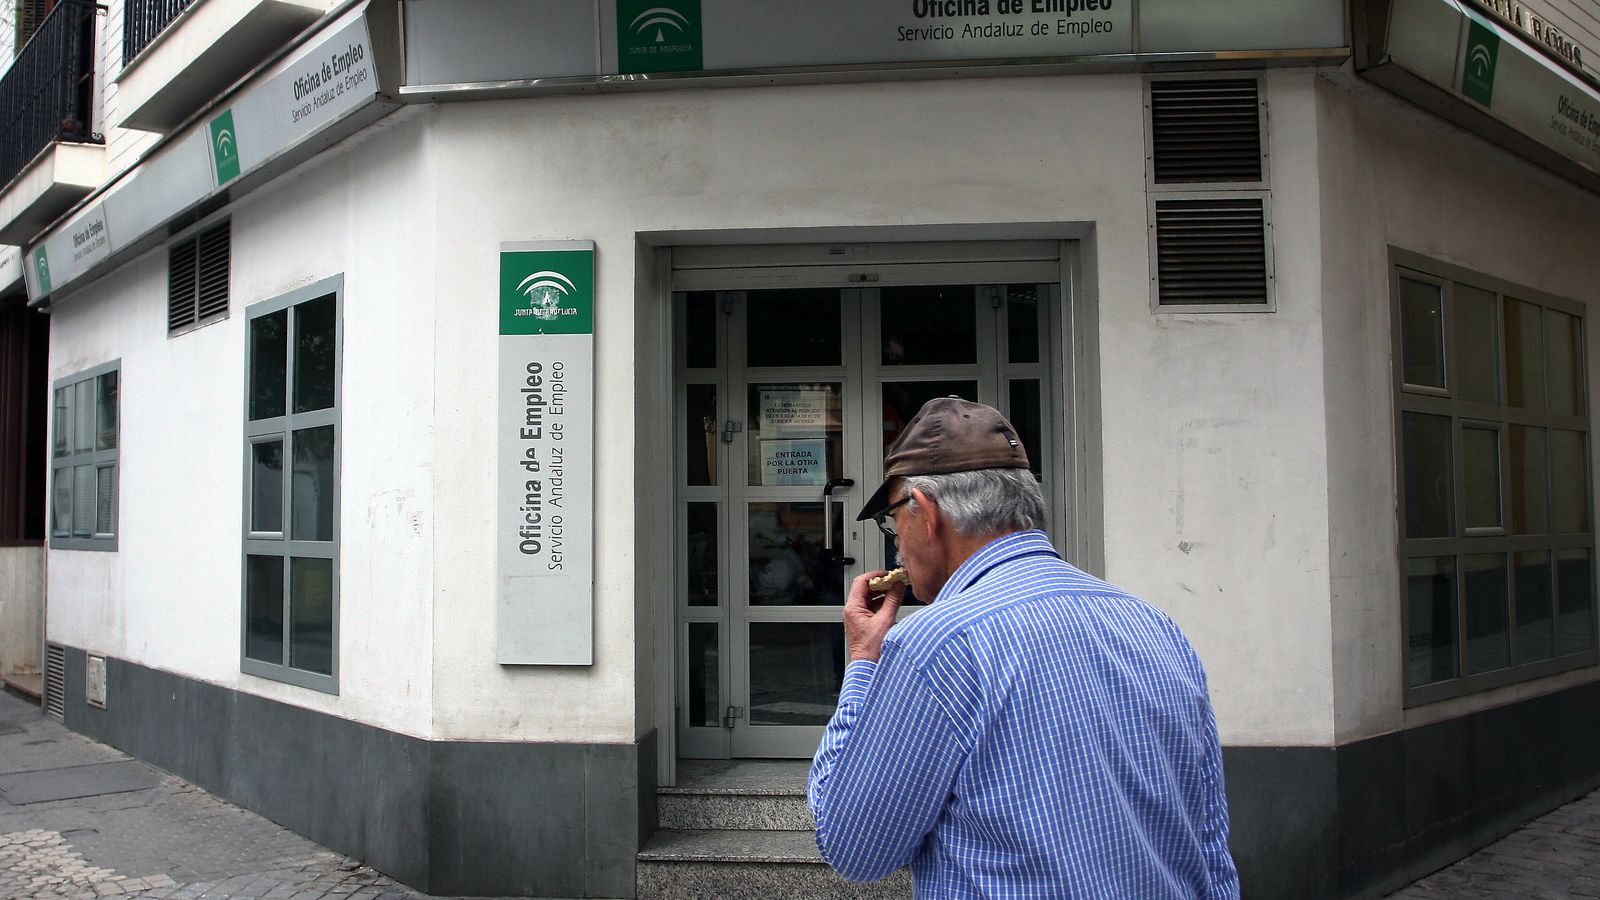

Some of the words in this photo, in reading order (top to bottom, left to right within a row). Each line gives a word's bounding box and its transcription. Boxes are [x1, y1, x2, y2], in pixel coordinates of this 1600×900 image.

[897, 25, 955, 42] Servicio
[961, 21, 1024, 39] Andaluz
[1030, 20, 1050, 37] de
[1057, 18, 1113, 38] Empleo
[912, 0, 990, 19] Oficina
[997, 0, 1024, 15] de
[291, 102, 313, 124] Servicio
[313, 88, 335, 111] Andaluz
[336, 81, 344, 97] de
[344, 68, 367, 90] Empleo
[293, 72, 321, 101] Oficina
[321, 61, 333, 84] de
[332, 43, 364, 73] Empleo
[519, 361, 548, 440] Empleo
[548, 361, 568, 415] Empleo
[548, 422, 563, 441] de
[519, 447, 541, 473] de
[548, 447, 563, 508] Andaluz
[519, 479, 542, 556] Oficina
[548, 514, 563, 571] Servicio
